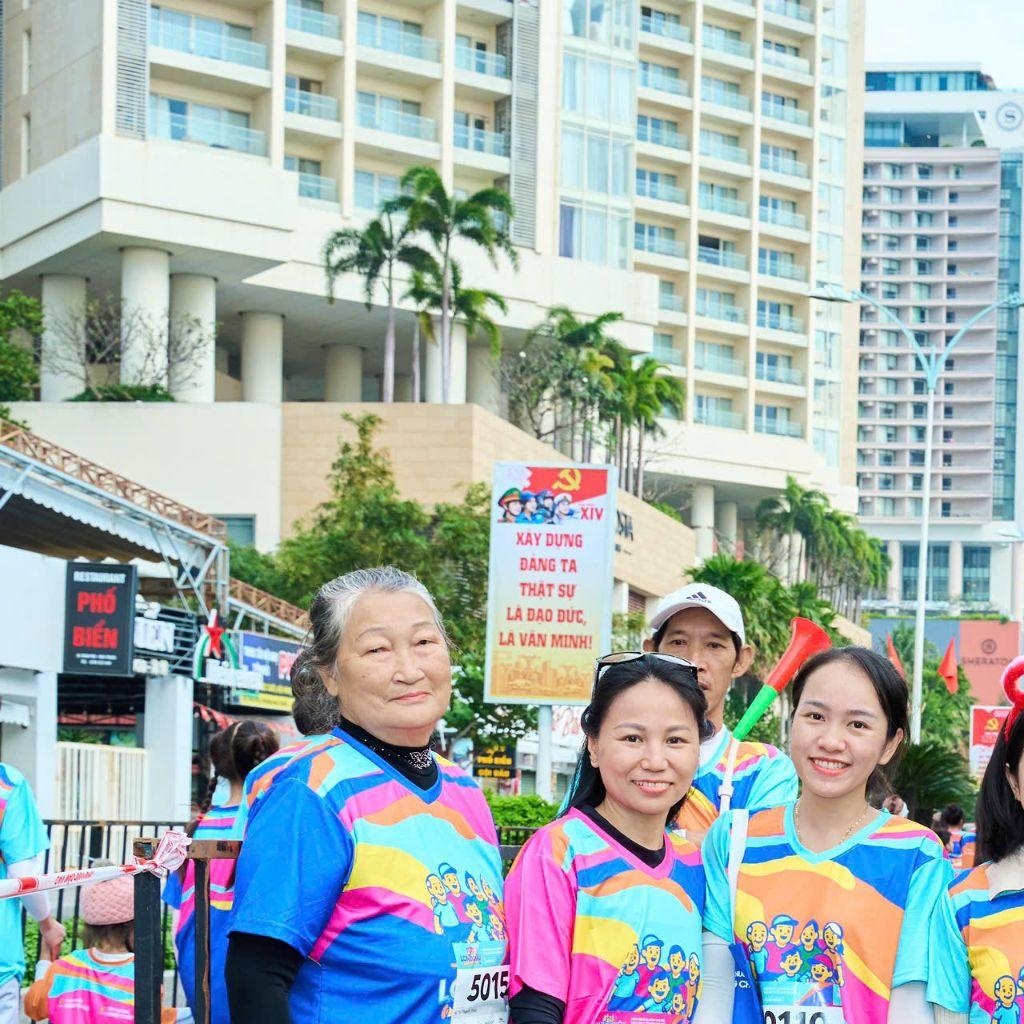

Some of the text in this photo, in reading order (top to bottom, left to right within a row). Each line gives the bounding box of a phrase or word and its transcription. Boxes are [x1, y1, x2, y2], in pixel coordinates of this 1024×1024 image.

[581, 506, 604, 521] XIV
[560, 558, 577, 573] TA
[550, 633, 592, 649] MINH!
